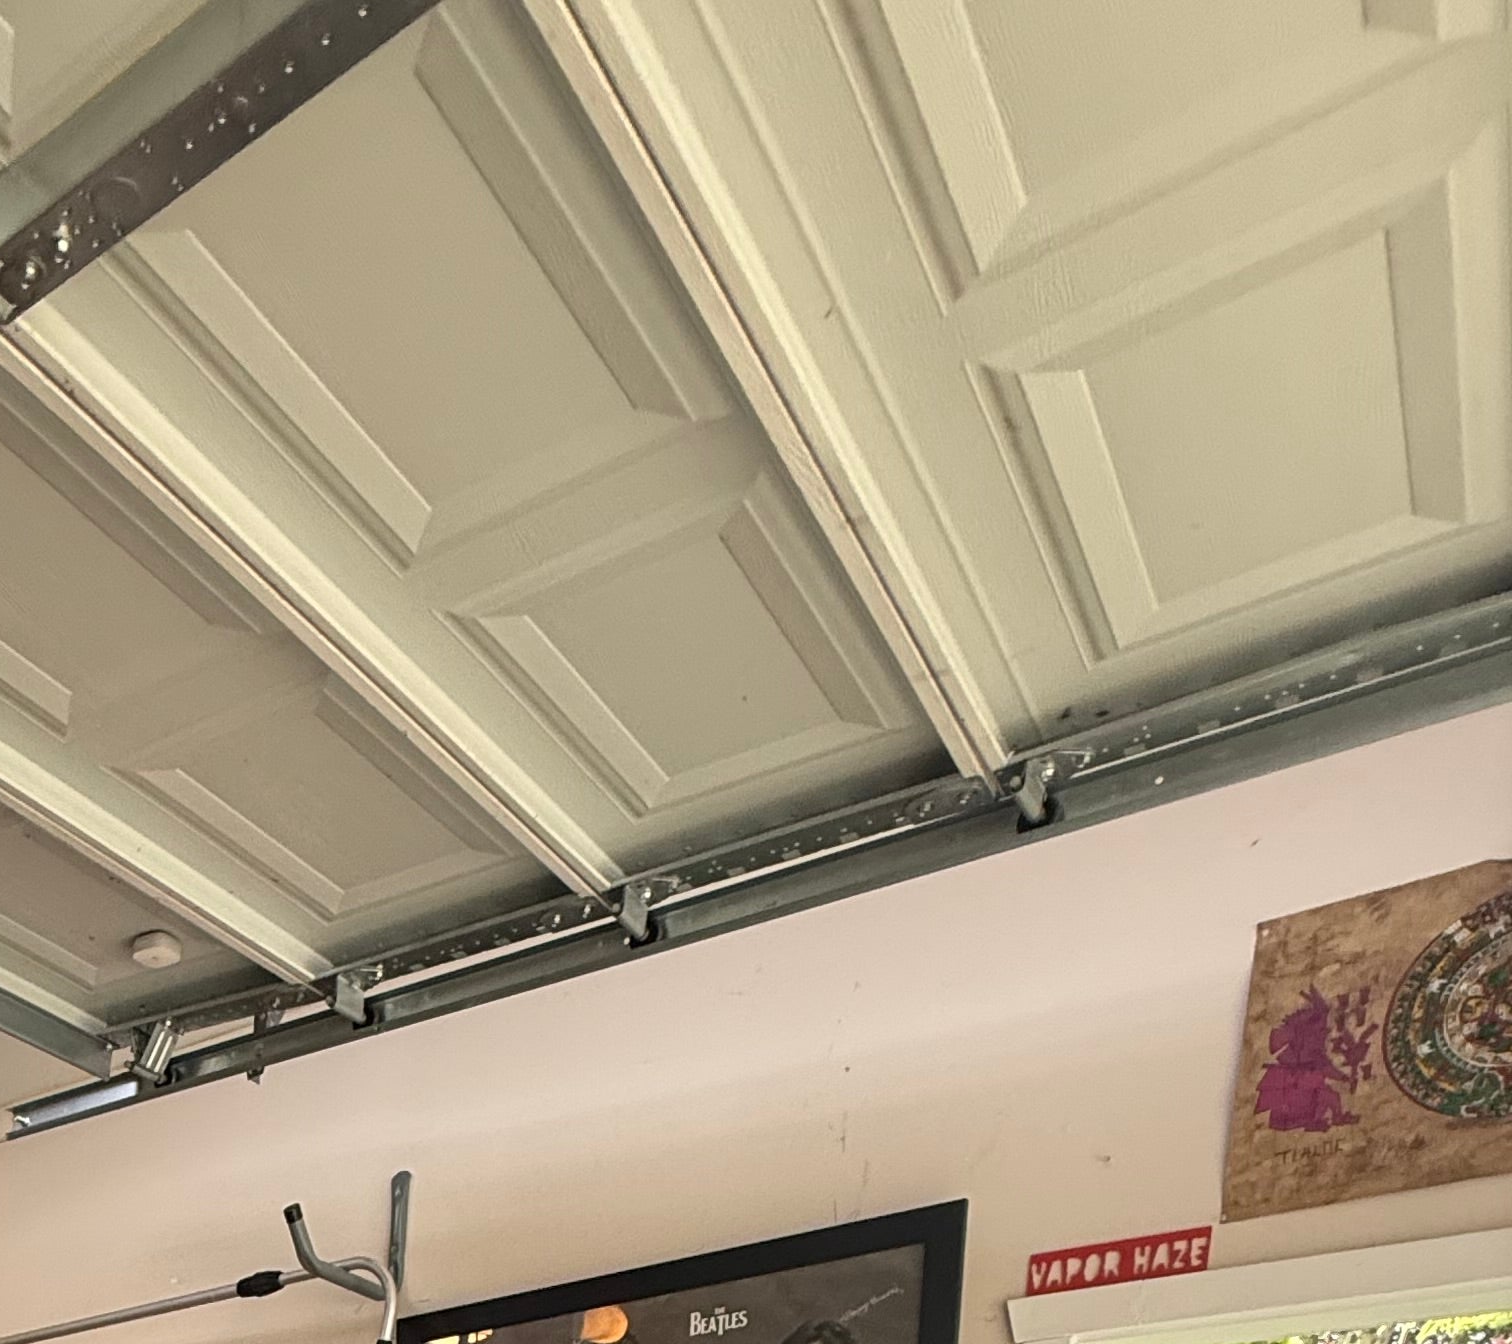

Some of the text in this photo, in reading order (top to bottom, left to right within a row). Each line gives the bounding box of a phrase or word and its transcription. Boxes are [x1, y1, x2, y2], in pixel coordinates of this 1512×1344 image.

[1031, 1237, 1208, 1290] VAPOR HAZE
[689, 1310, 748, 1337] BEATLES
